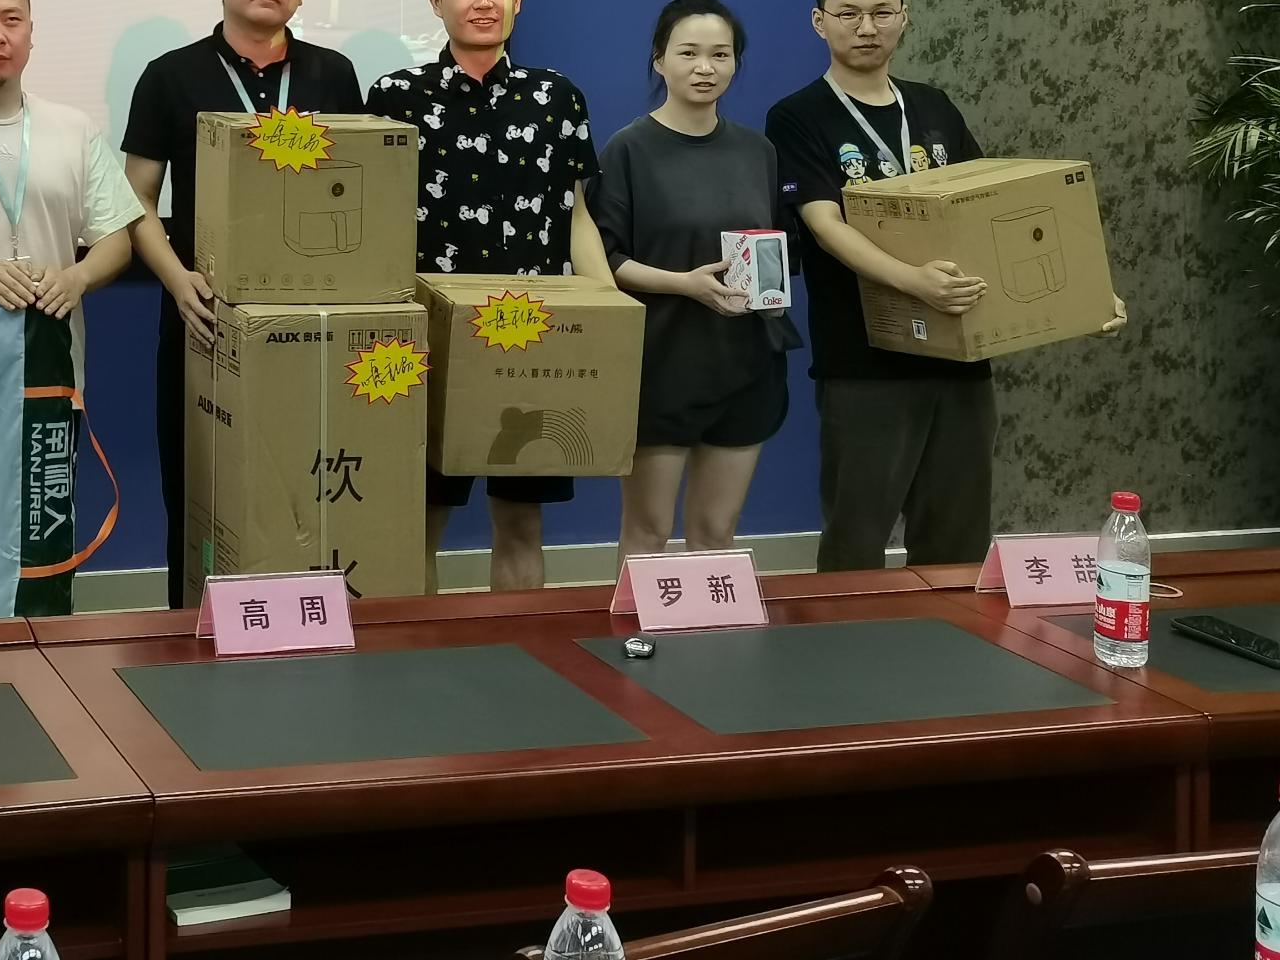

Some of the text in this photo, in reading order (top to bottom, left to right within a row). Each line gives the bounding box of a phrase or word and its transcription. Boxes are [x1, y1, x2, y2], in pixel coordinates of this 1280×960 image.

[762, 296, 783, 306] Coke
[266, 331, 302, 344] AUX
[494, 367, 600, 380] 年轻人喜欢的小家电
[28, 422, 43, 541] NANJIREN
[43, 420, 70, 540] 南极人
[1023, 553, 1098, 585] 李喆
[656, 573, 737, 608] 罗新
[239, 594, 328, 632] 高周
